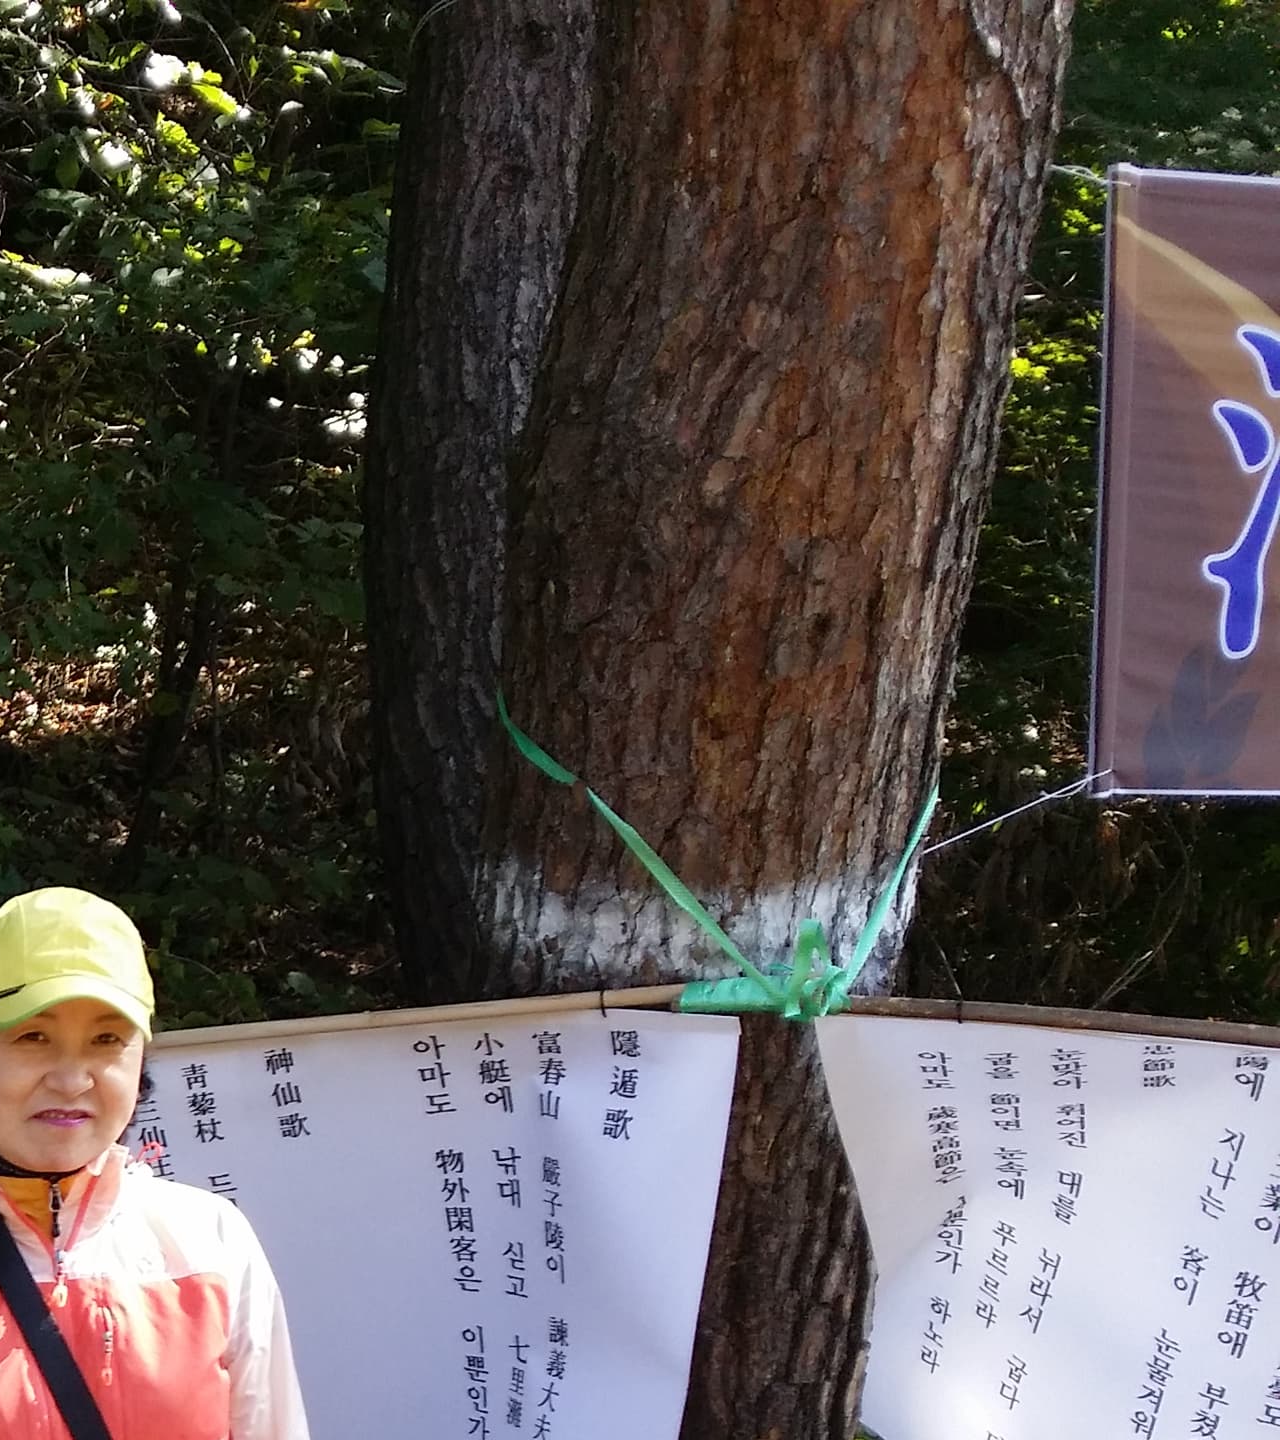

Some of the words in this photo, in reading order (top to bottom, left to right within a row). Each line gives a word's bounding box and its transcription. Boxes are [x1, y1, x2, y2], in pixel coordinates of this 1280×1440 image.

[264, 1047, 311, 1138] 神仙歌
[412, 1035, 457, 1115] 아마도
[531, 1031, 566, 1120] 富春山
[917, 1052, 957, 1089] 아마도
[492, 1146, 522, 1208] 낚대
[1198, 1128, 1247, 1220] 지나는
[1019, 1247, 1061, 1334] 뉘라서
[920, 1296, 952, 1374] 하노라
[1130, 1328, 1182, 1440] 눈물겨워
